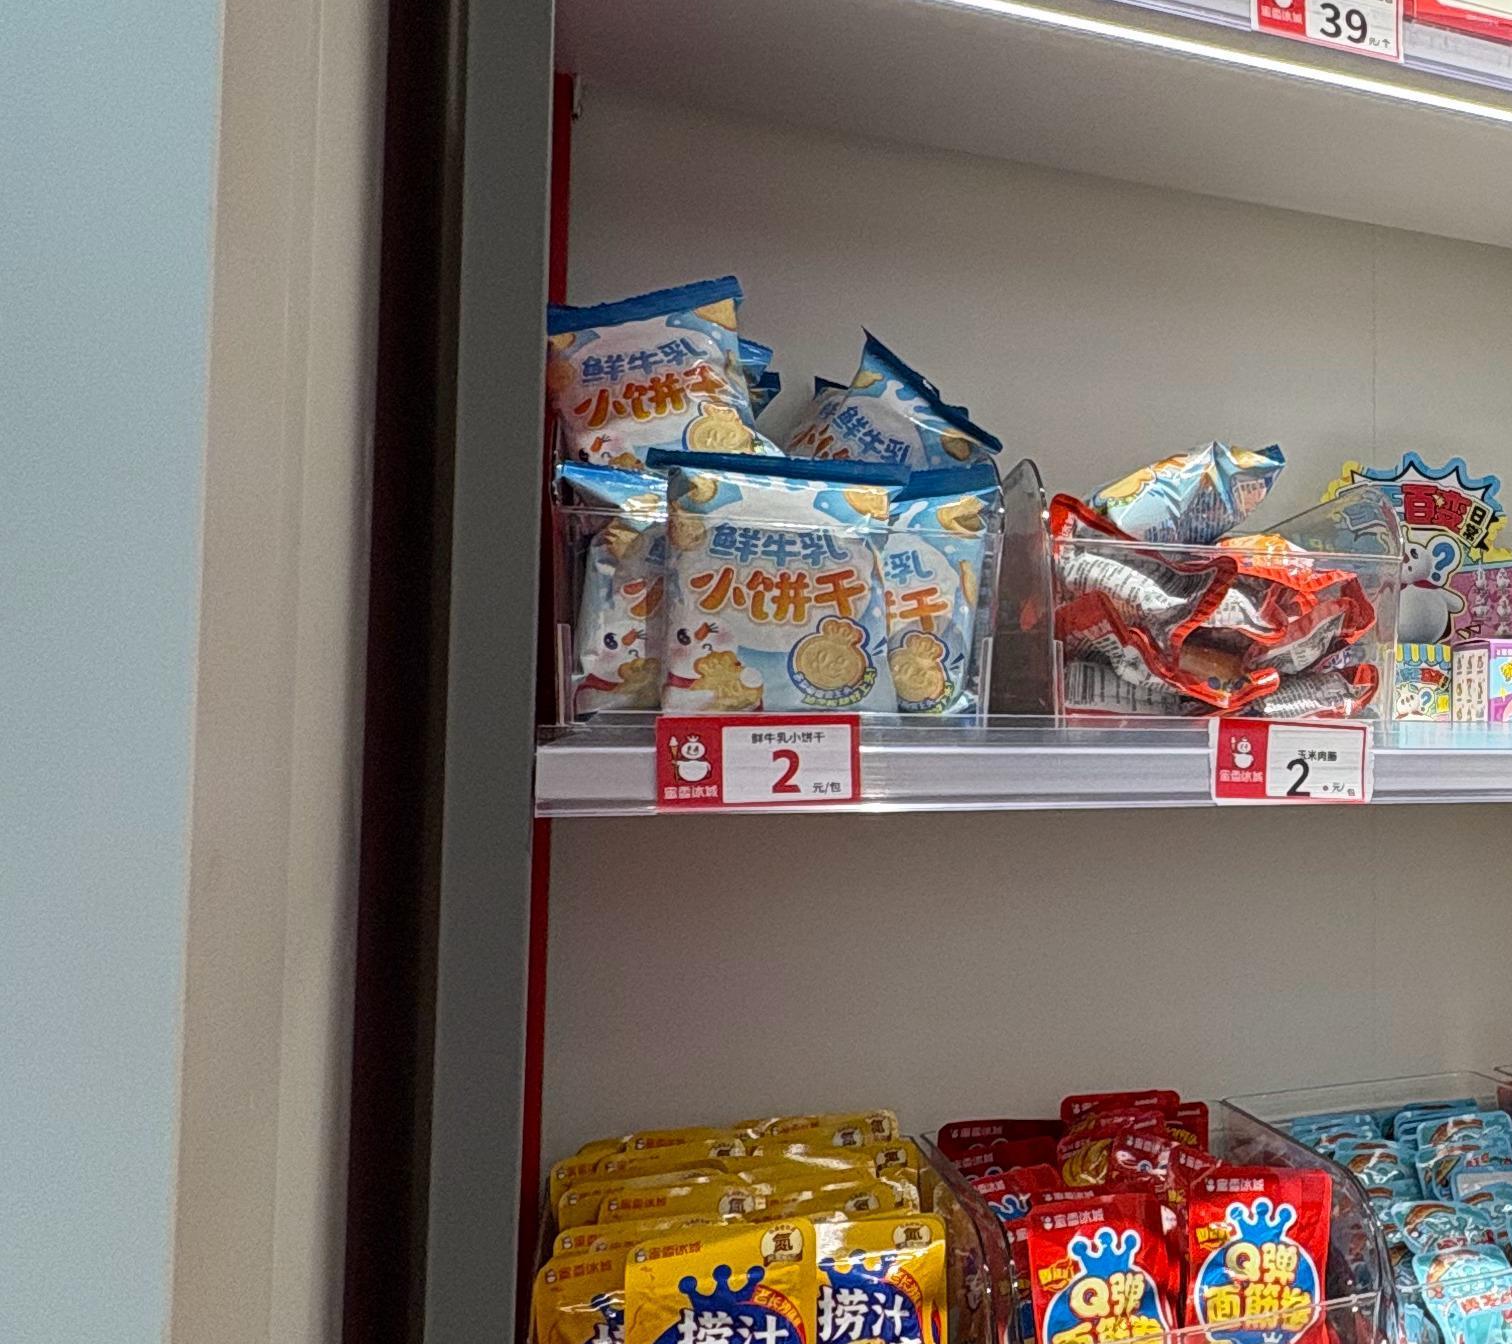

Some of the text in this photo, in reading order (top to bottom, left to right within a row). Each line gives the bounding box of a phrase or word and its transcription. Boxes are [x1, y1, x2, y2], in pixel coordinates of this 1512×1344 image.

[1319, 2, 1368, 44] 39
[580, 336, 709, 385] 鲜牛乳
[573, 364, 730, 429] 小饼干
[708, 523, 850, 567] 鲜牛乳
[689, 566, 869, 624] 小饼干
[751, 731, 826, 745] 鲜牛乳小饼干
[771, 748, 802, 795] 2
[812, 782, 842, 794] 元/包
[1286, 757, 1311, 797] 2
[1216, 1178, 1265, 1193] 蜜雪冰城
[1053, 1208, 1105, 1229] 蜜雪冰城
[1225, 1242, 1298, 1283] Q弹
[817, 1285, 911, 1341] 捞汁
[1070, 1271, 1146, 1319] Q弹
[1205, 1283, 1312, 1330] 面筋卷
